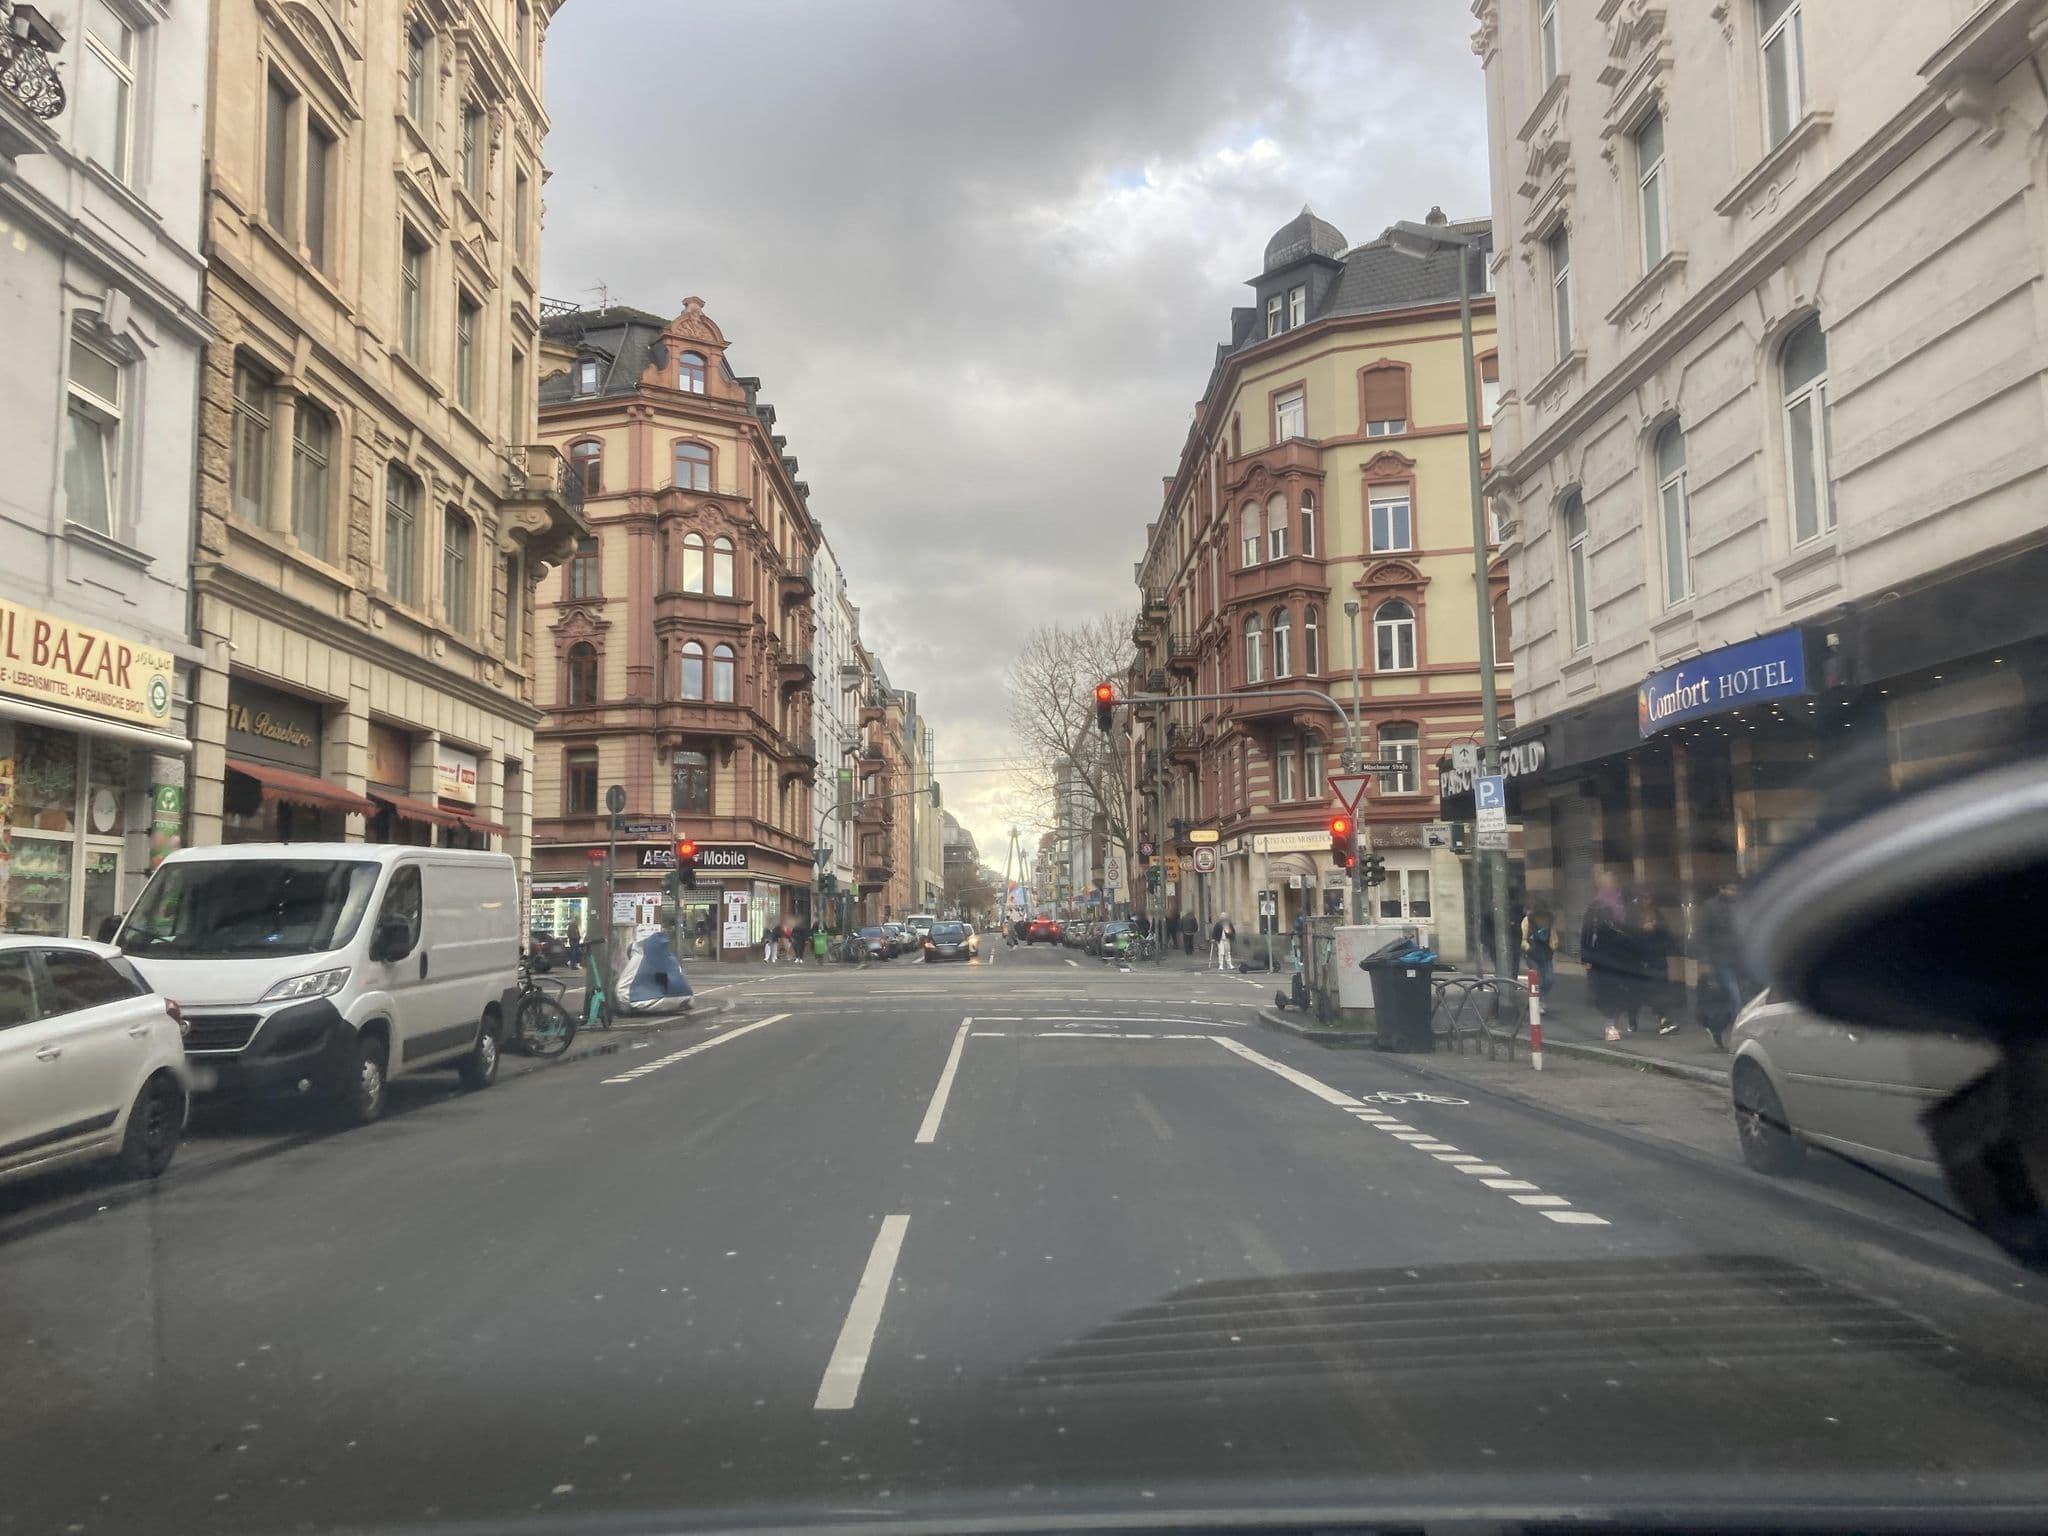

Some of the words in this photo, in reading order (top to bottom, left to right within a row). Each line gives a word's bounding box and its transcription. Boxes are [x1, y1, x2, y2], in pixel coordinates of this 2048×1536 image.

[0, 608, 20, 660] L
[32, 619, 132, 690] BAZAR
[12, 671, 70, 697] LEBENSMITTEL
[75, 686, 125, 711] AFGHANISCHE
[125, 698, 145, 714] BROT
[1648, 672, 1711, 722] Comfort
[1719, 660, 1794, 699] HOTEL
[1500, 742, 1542, 780] GOLD
[703, 850, 746, 866] Mobile
